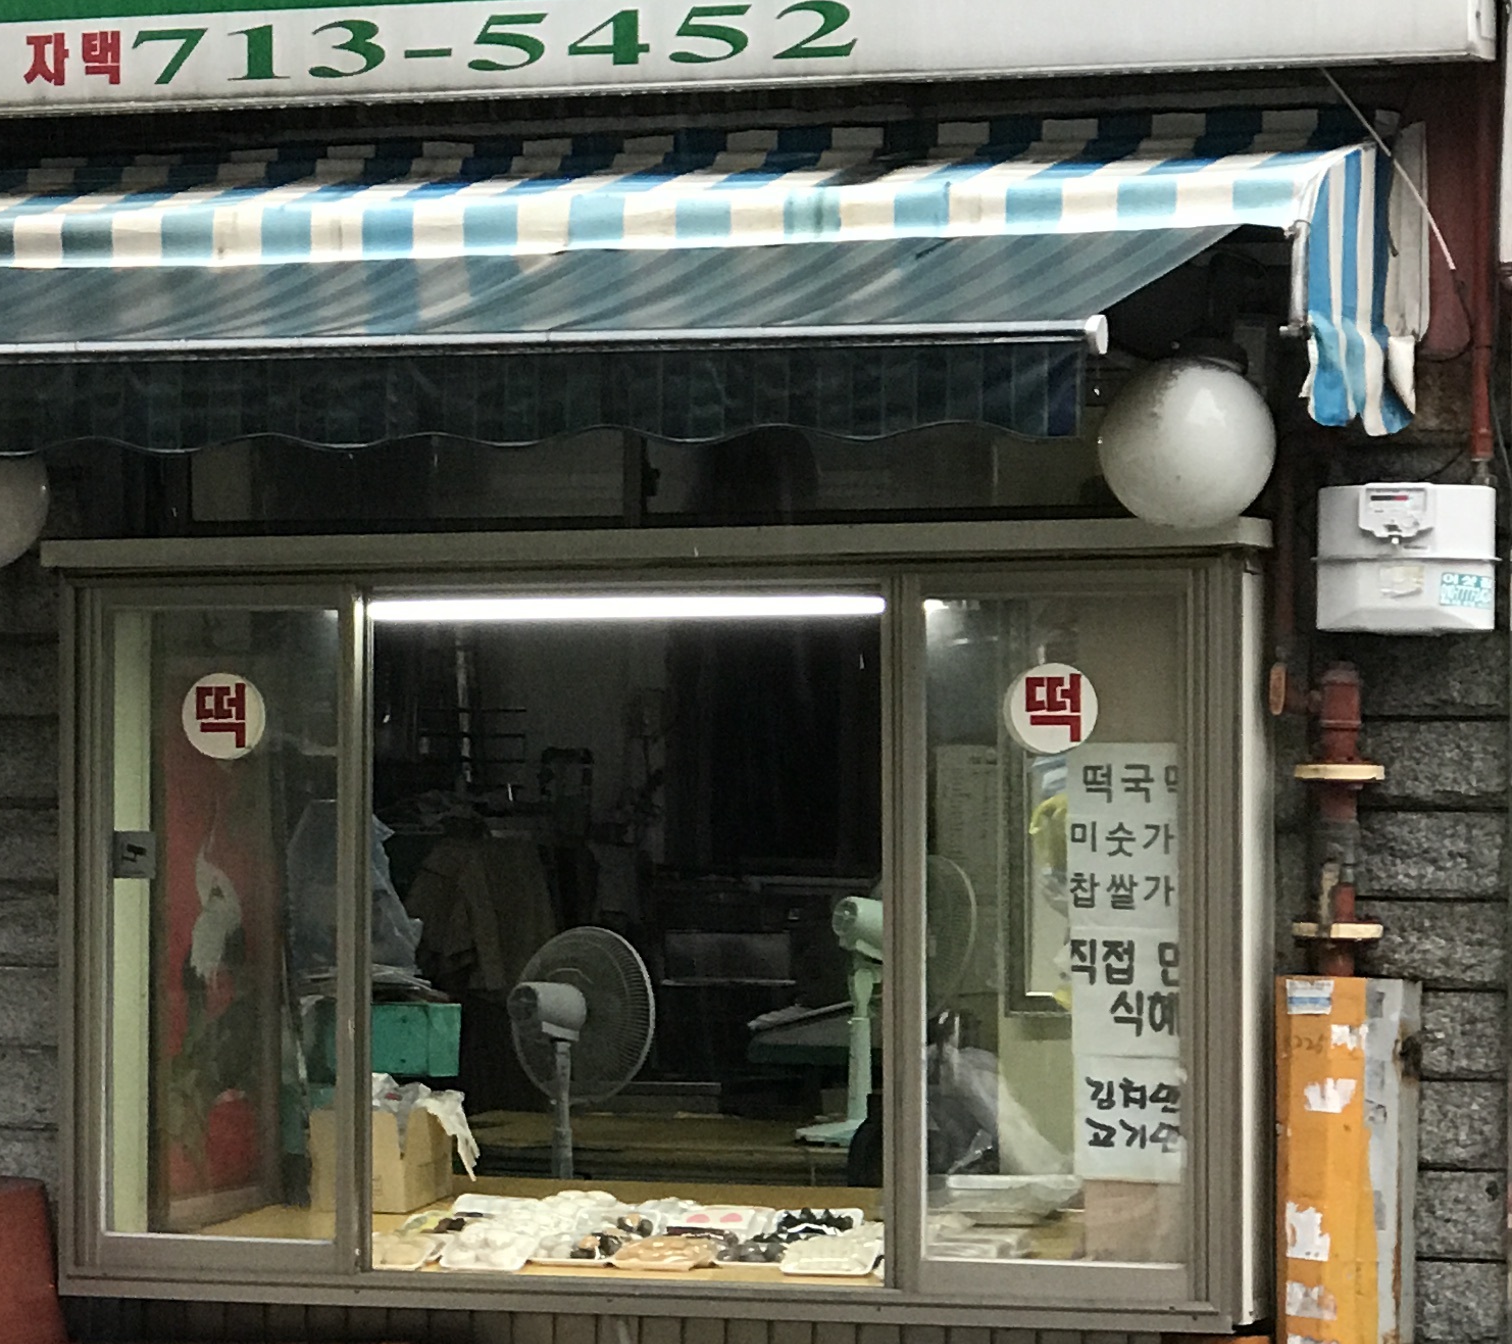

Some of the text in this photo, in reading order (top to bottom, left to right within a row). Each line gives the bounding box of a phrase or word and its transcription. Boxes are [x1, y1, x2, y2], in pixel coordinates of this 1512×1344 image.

[24, 0, 861, 87] 자택 713-5452
[195, 682, 246, 748] 떡
[1025, 673, 1082, 742] 떡
[1070, 938, 1135, 986] 직접
